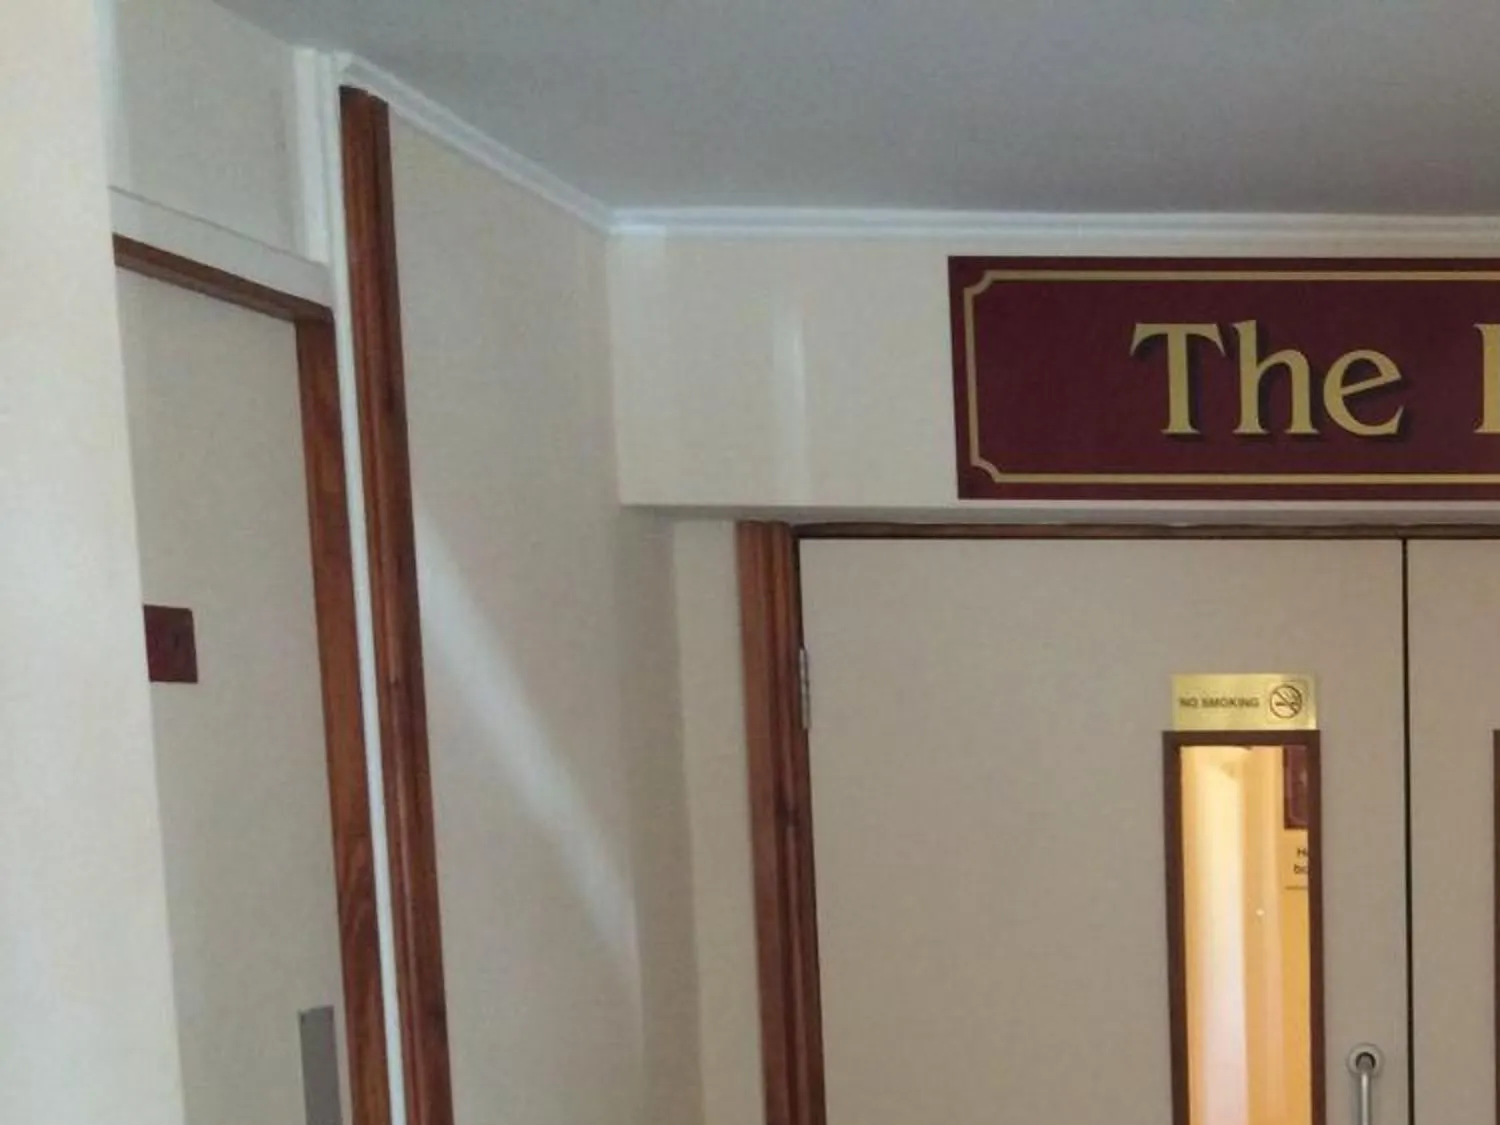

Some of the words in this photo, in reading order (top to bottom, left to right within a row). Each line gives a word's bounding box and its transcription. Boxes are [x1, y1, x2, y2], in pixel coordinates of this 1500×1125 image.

[1130, 319, 1404, 436] The
[1179, 697, 1199, 708] NO
[1200, 697, 1260, 708] SMOKING
